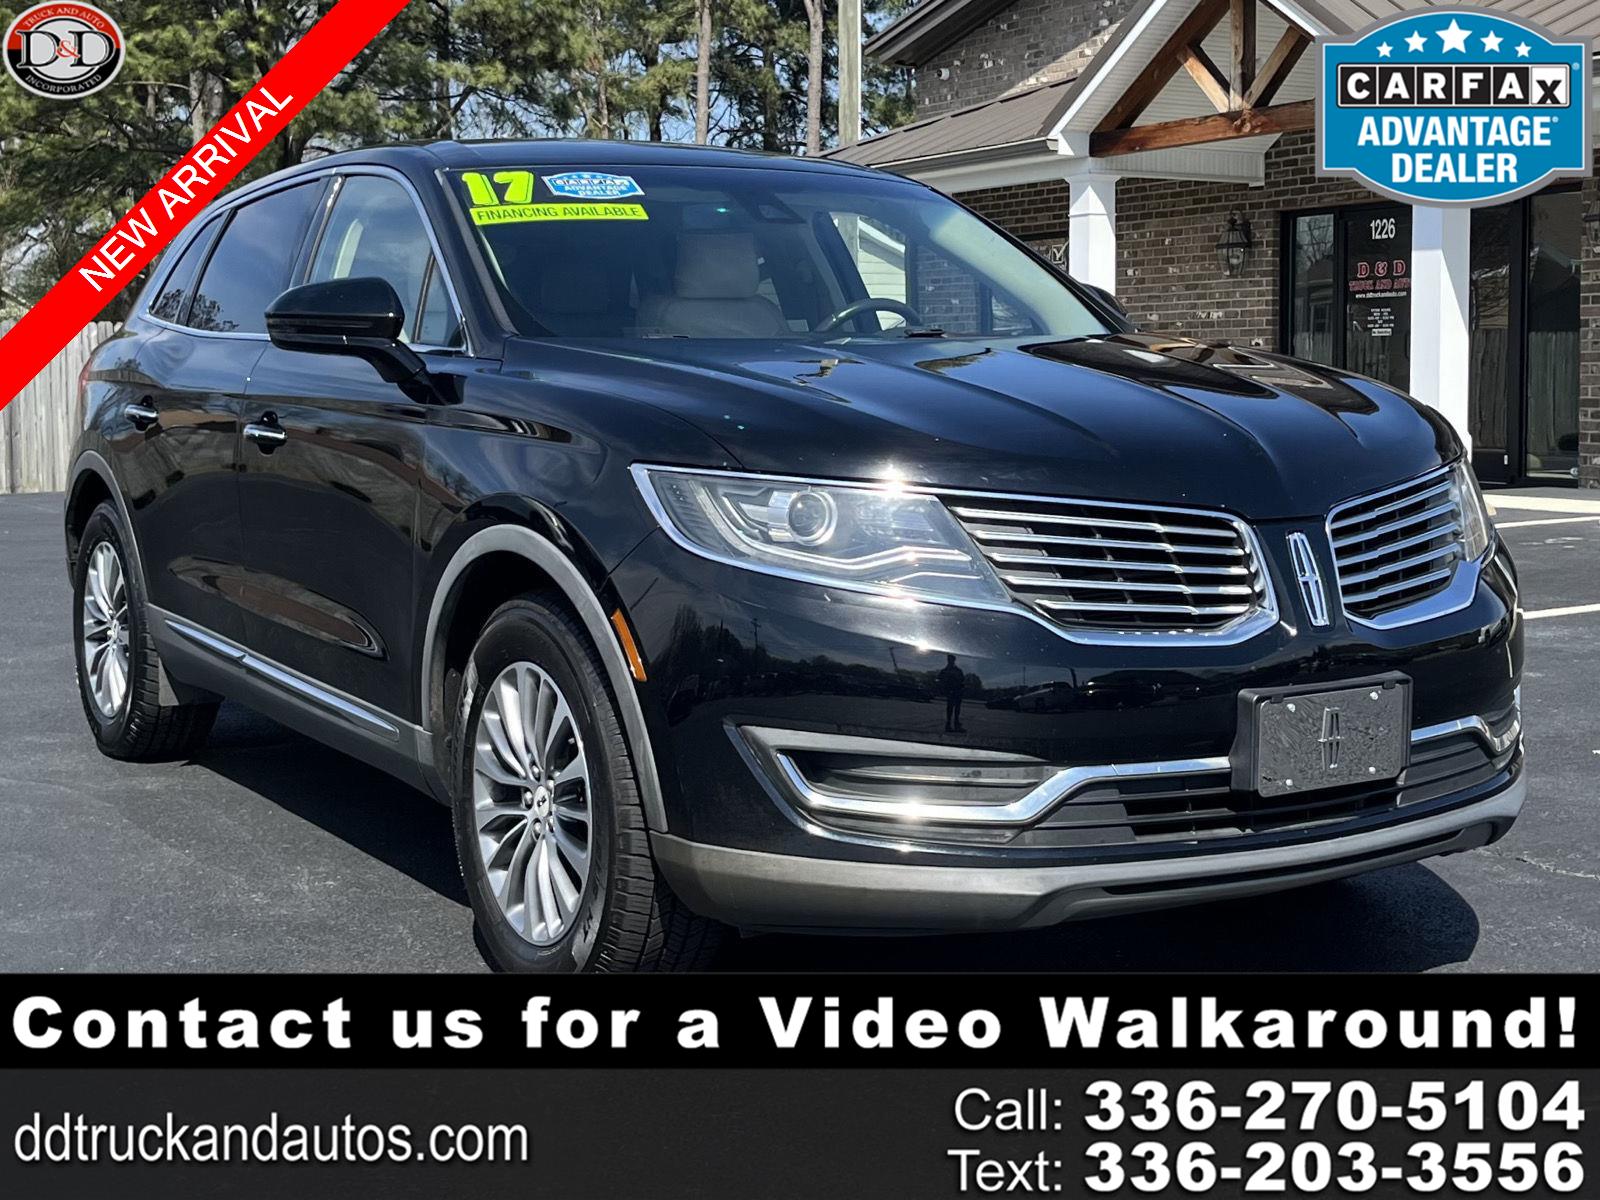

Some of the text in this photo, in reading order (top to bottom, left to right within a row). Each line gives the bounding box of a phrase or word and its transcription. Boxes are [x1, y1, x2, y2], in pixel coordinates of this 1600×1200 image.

[461, 170, 534, 206] 17
[477, 205, 642, 221] FINANCING AVAILABLE
[1370, 218, 1395, 240] 1226
[1357, 260, 1406, 278] D & D
